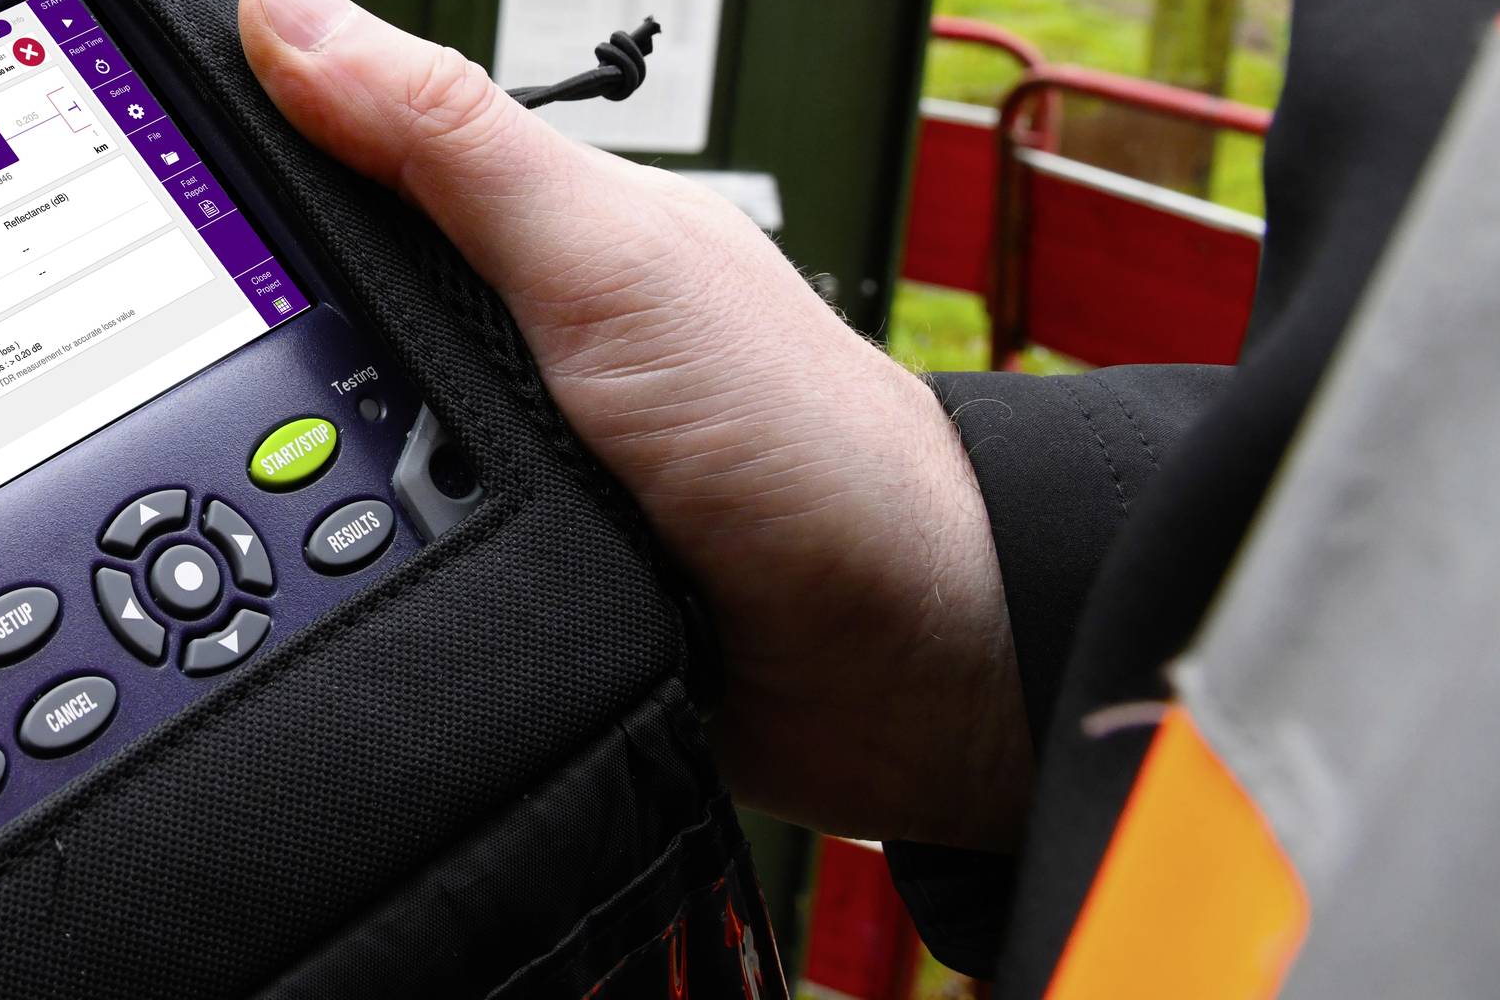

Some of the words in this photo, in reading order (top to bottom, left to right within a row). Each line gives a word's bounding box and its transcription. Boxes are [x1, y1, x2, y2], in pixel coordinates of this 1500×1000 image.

[68, 44, 86, 56] Real
[84, 37, 104, 48] Time
[109, 84, 131, 98] Setup
[15, 111, 39, 127] 0.205
[147, 132, 162, 142] File
[93, 143, 109, 154] km
[180, 176, 198, 188] Fast
[183, 183, 209, 199] Report
[3, 203, 51, 230] Reflectance
[50, 193, 69, 208] (dB)
[251, 271, 272, 285] Close
[256, 279, 282, 296] Project
[0, 344, 16, 356] loss
[14, 348, 32, 362] 0.20
[31, 342, 43, 353] dB
[16, 348, 63, 378] measurement
[61, 343, 72, 352] for
[72, 328, 102, 347] accurate
[100, 319, 117, 331] loss
[116, 309, 136, 323] value
[331, 365, 379, 395] Testing
[260, 423, 330, 476] START/STOP
[326, 510, 381, 553] RESULTS
[45, 691, 98, 733] CANCEL
